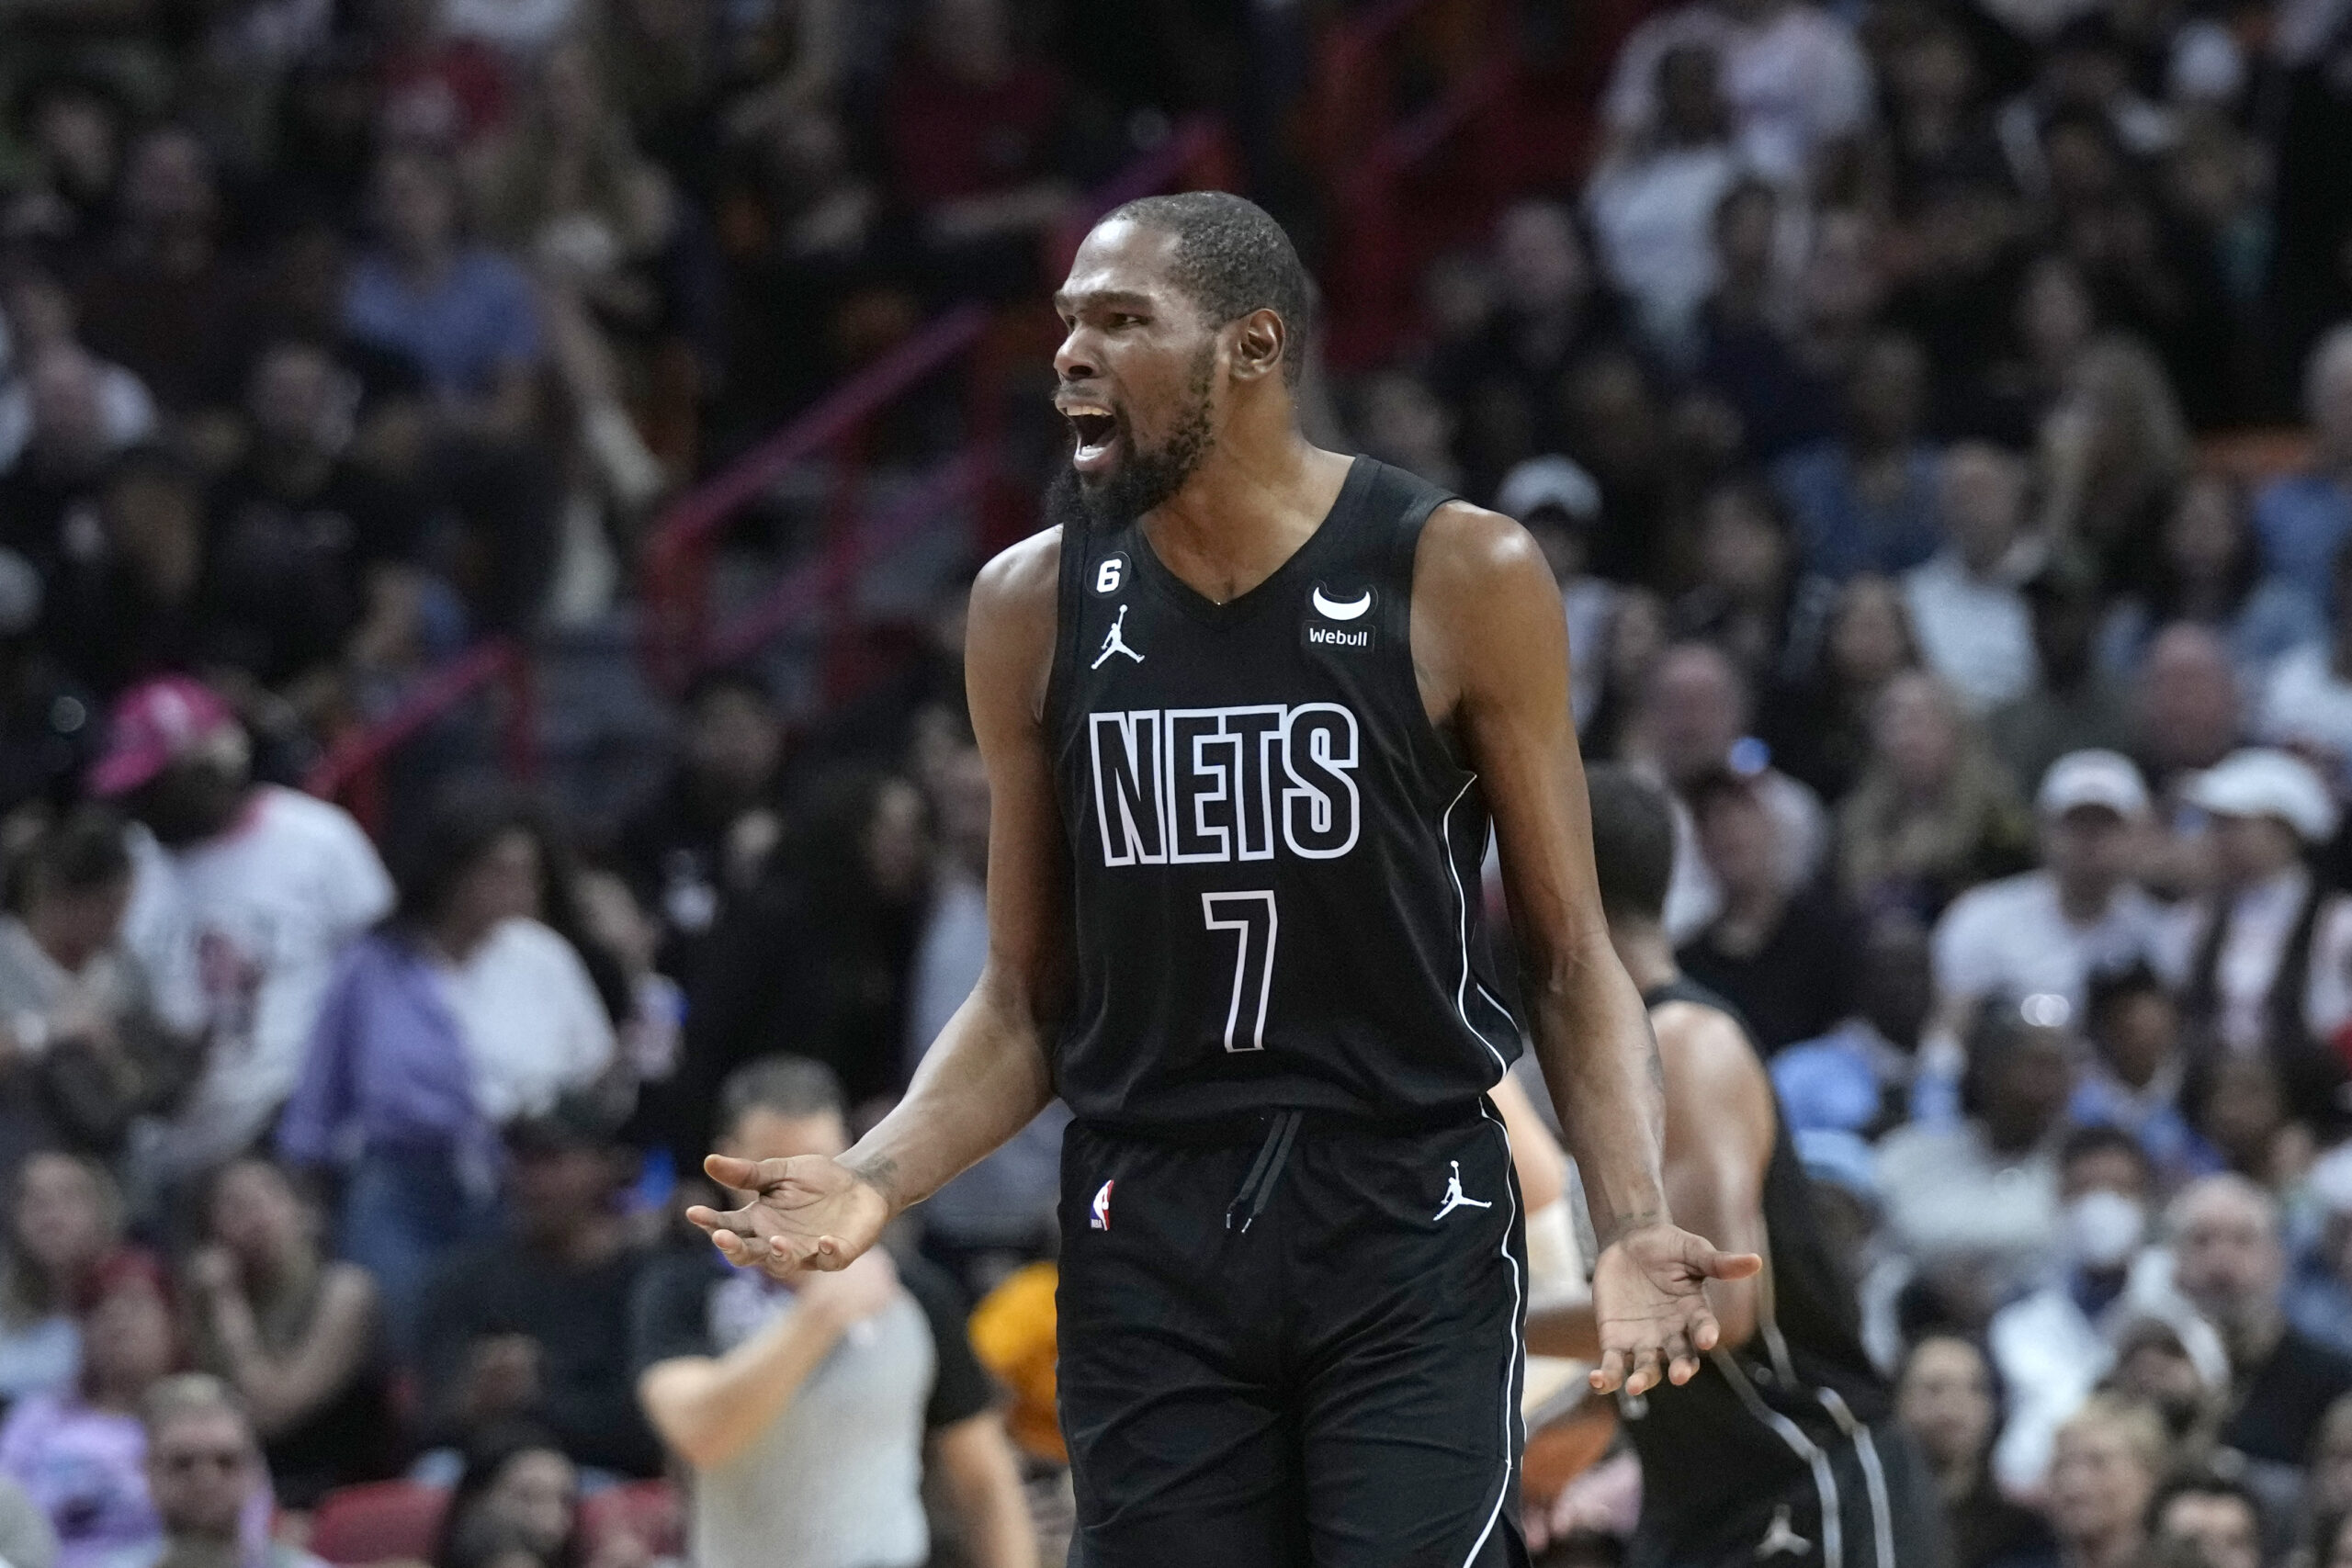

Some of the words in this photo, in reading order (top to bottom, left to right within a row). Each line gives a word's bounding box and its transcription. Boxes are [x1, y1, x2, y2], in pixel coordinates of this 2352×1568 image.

[1096, 558, 1123, 593] 6
[1309, 627, 1368, 647] Webull
[1089, 702, 1360, 867] NETS
[1201, 889, 1278, 1054] 7
